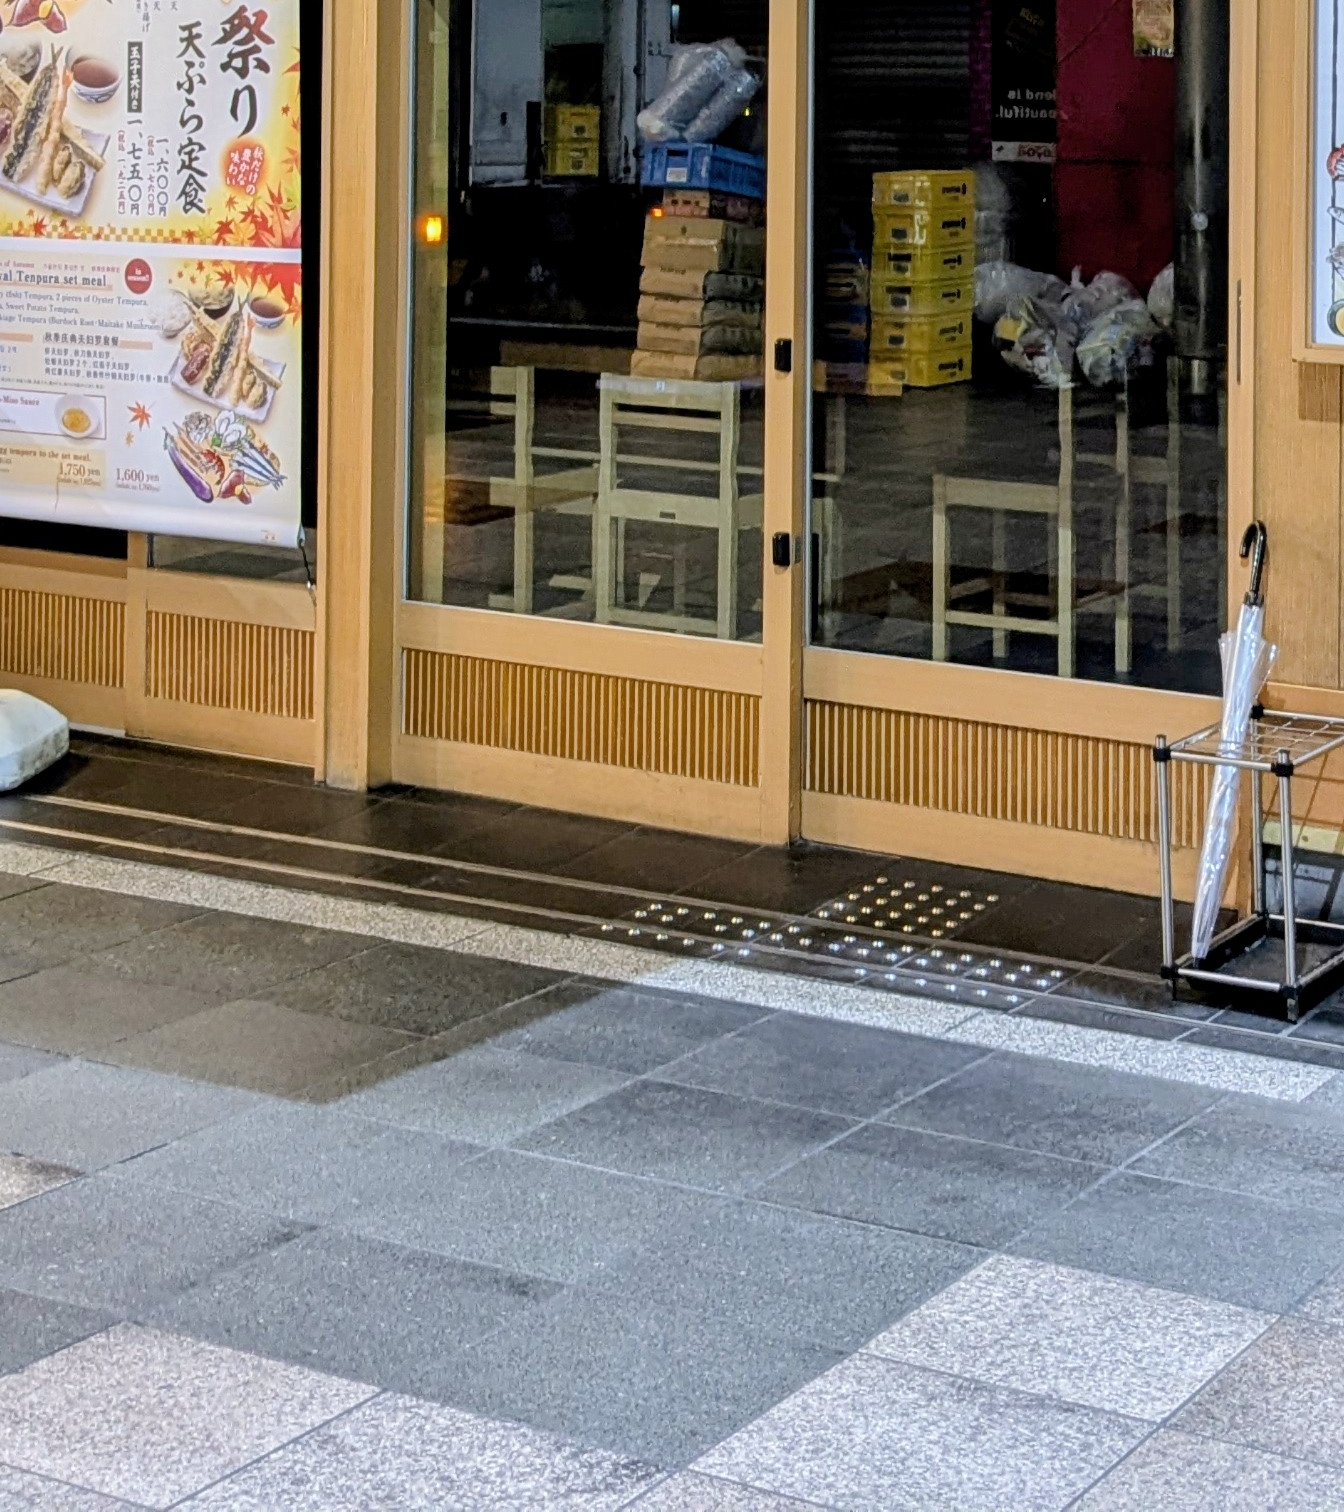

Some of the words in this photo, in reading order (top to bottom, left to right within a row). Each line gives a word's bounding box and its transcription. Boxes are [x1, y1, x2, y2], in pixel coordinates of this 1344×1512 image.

[176, 20, 208, 215] 天ぷら定食
[63, 275, 78, 285] set
[81, 275, 106, 286] meal
[116, 468, 145, 481] 1,600
